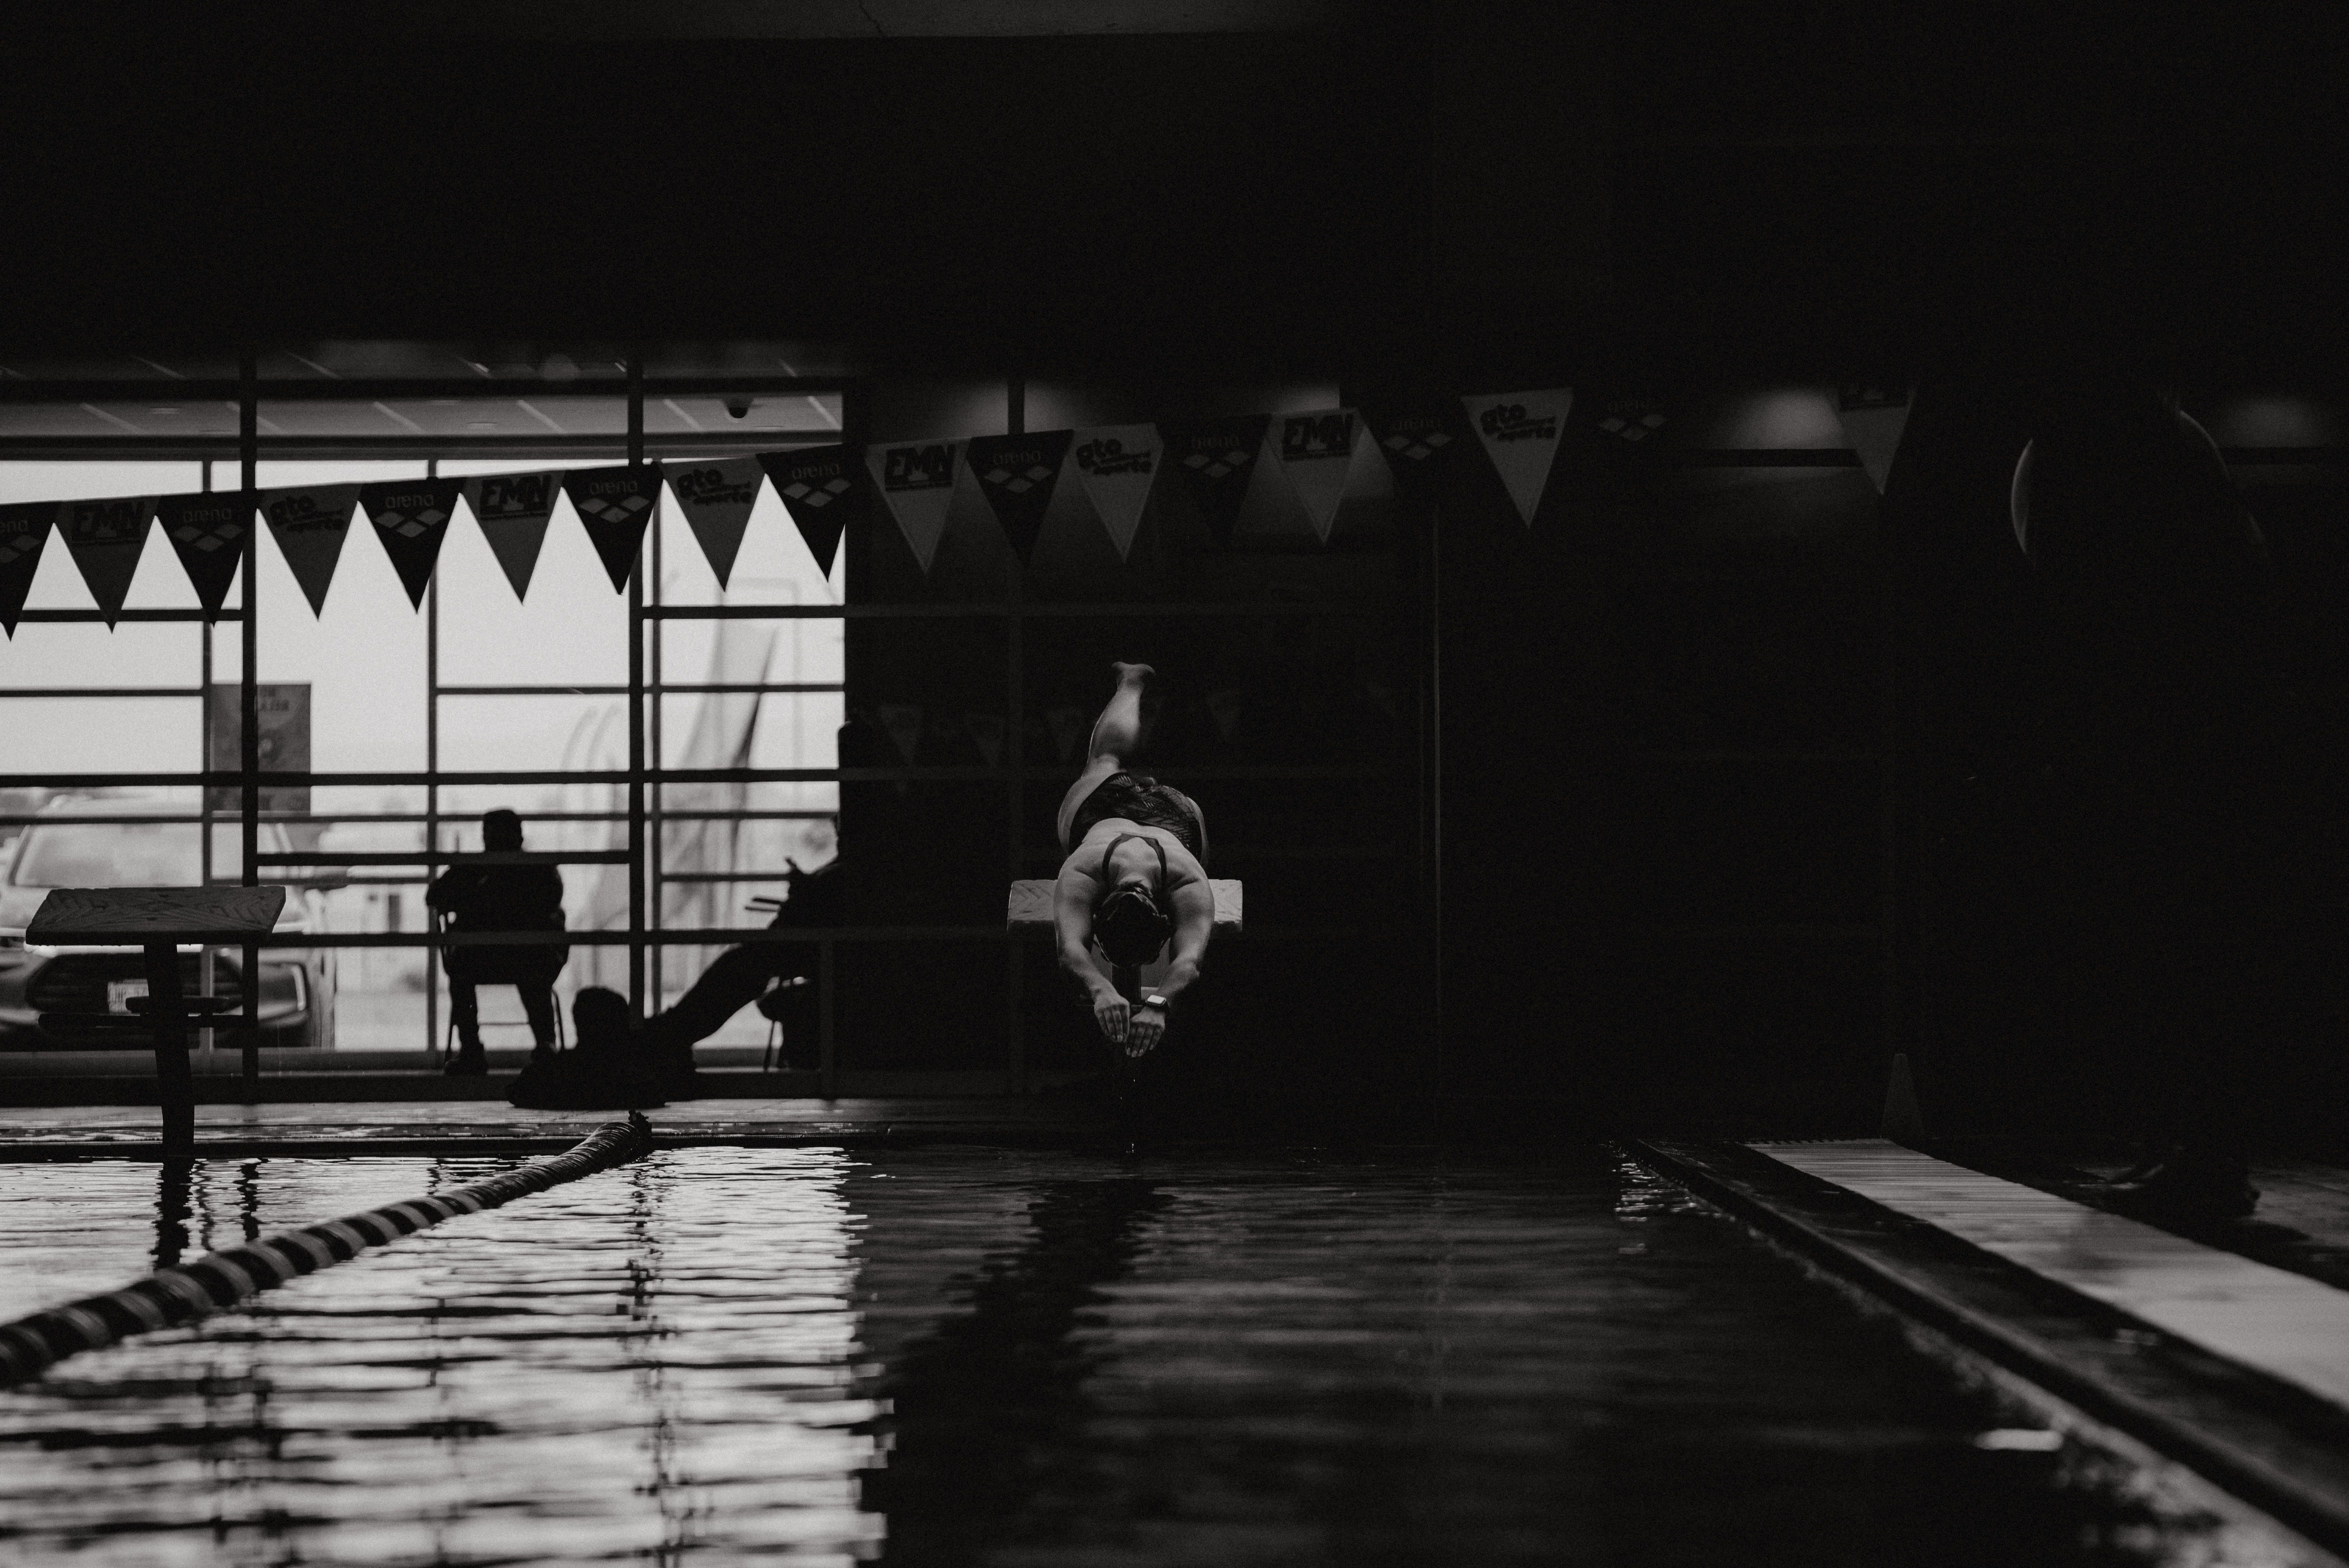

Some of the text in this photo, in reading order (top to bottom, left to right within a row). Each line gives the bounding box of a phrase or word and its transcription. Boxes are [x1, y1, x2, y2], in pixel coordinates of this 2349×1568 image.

[993, 450, 1041, 466] arena
[791, 462, 840, 480] arena
[588, 479, 638, 495] arena
[385, 493, 435, 508] arena
[182, 508, 233, 524] arena
